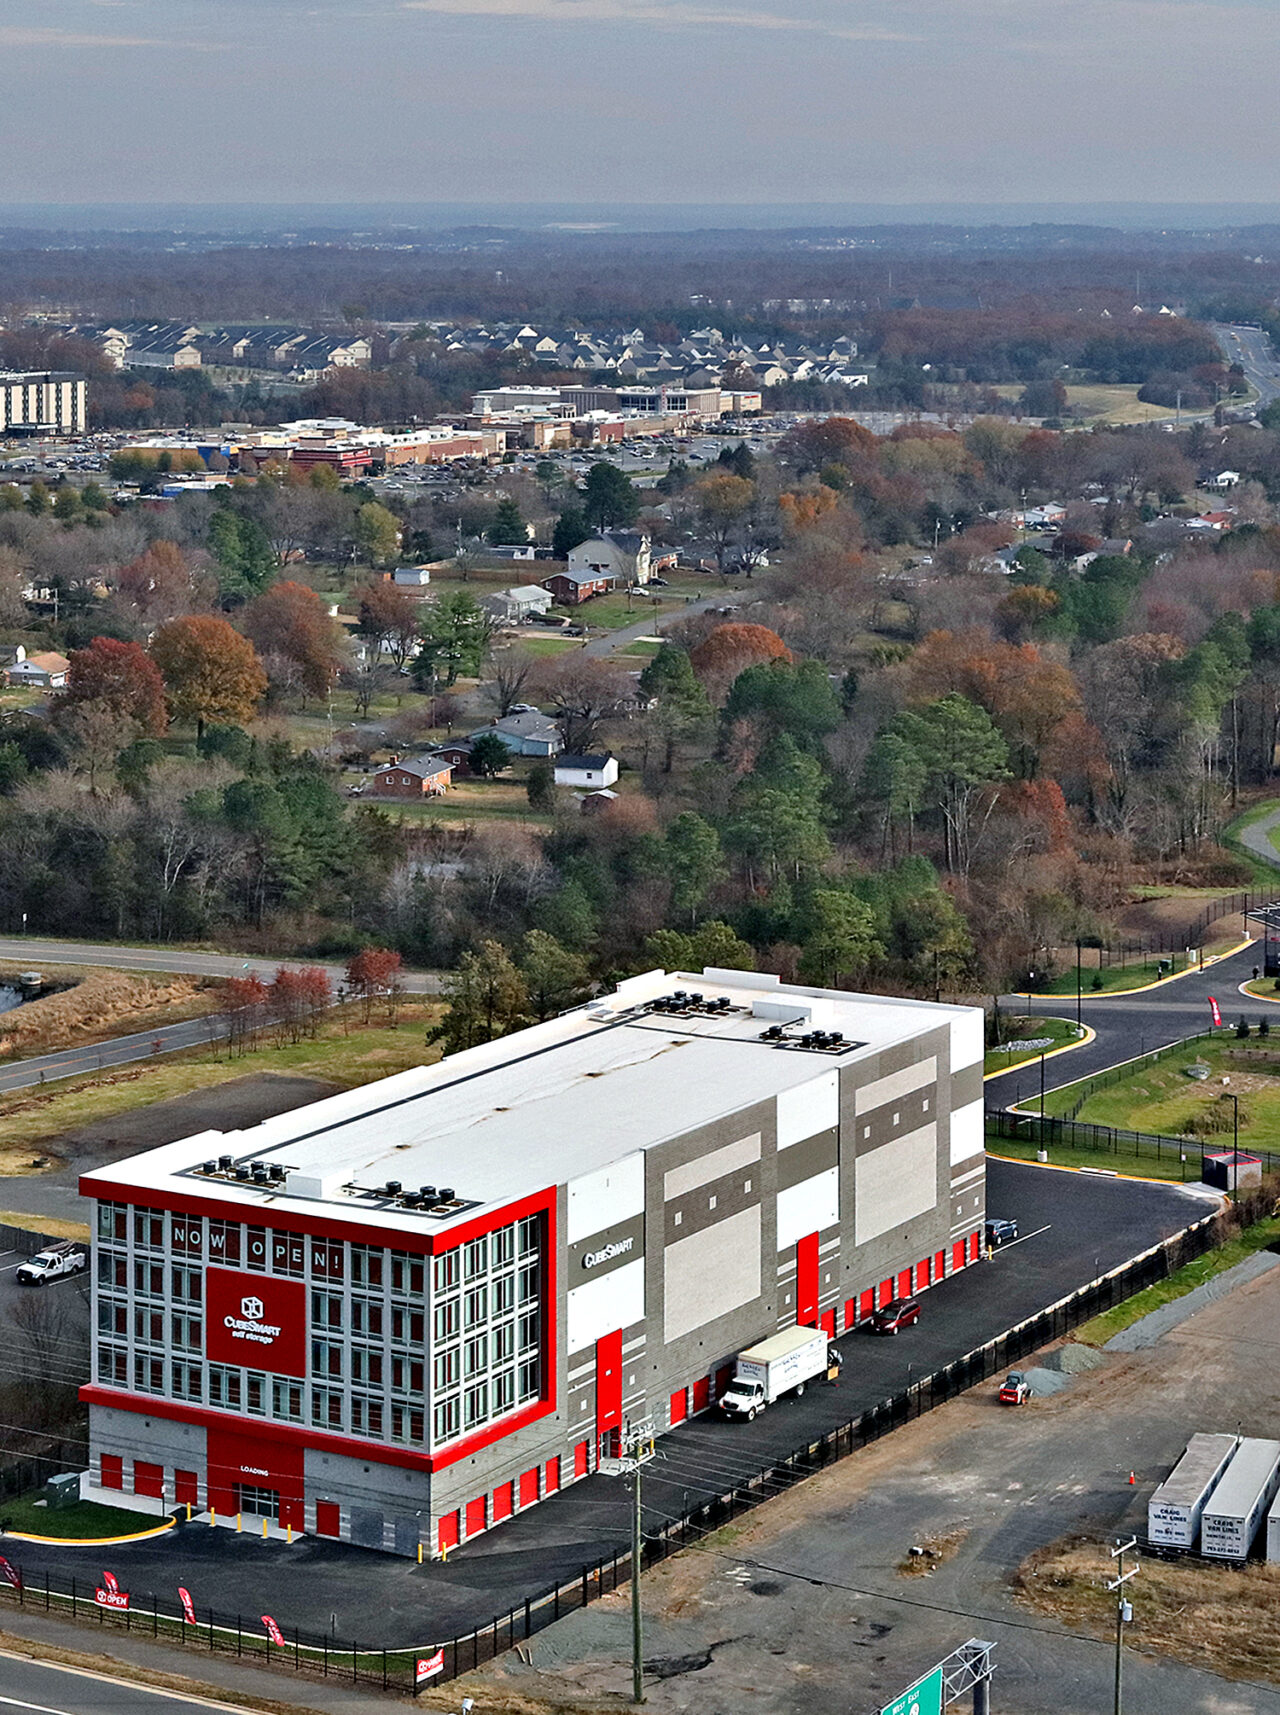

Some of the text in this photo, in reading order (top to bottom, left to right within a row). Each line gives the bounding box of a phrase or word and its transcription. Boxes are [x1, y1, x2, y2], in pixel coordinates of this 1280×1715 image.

[174, 1228, 340, 1269] NOW OPEN!
[231, 1329, 274, 1344] self storage
[240, 1465, 269, 1477] LOADING
[1160, 1508, 1180, 1516] CRAIG
[1212, 1519, 1233, 1527] CRAIG
[908, 1690, 920, 1704] EAST
